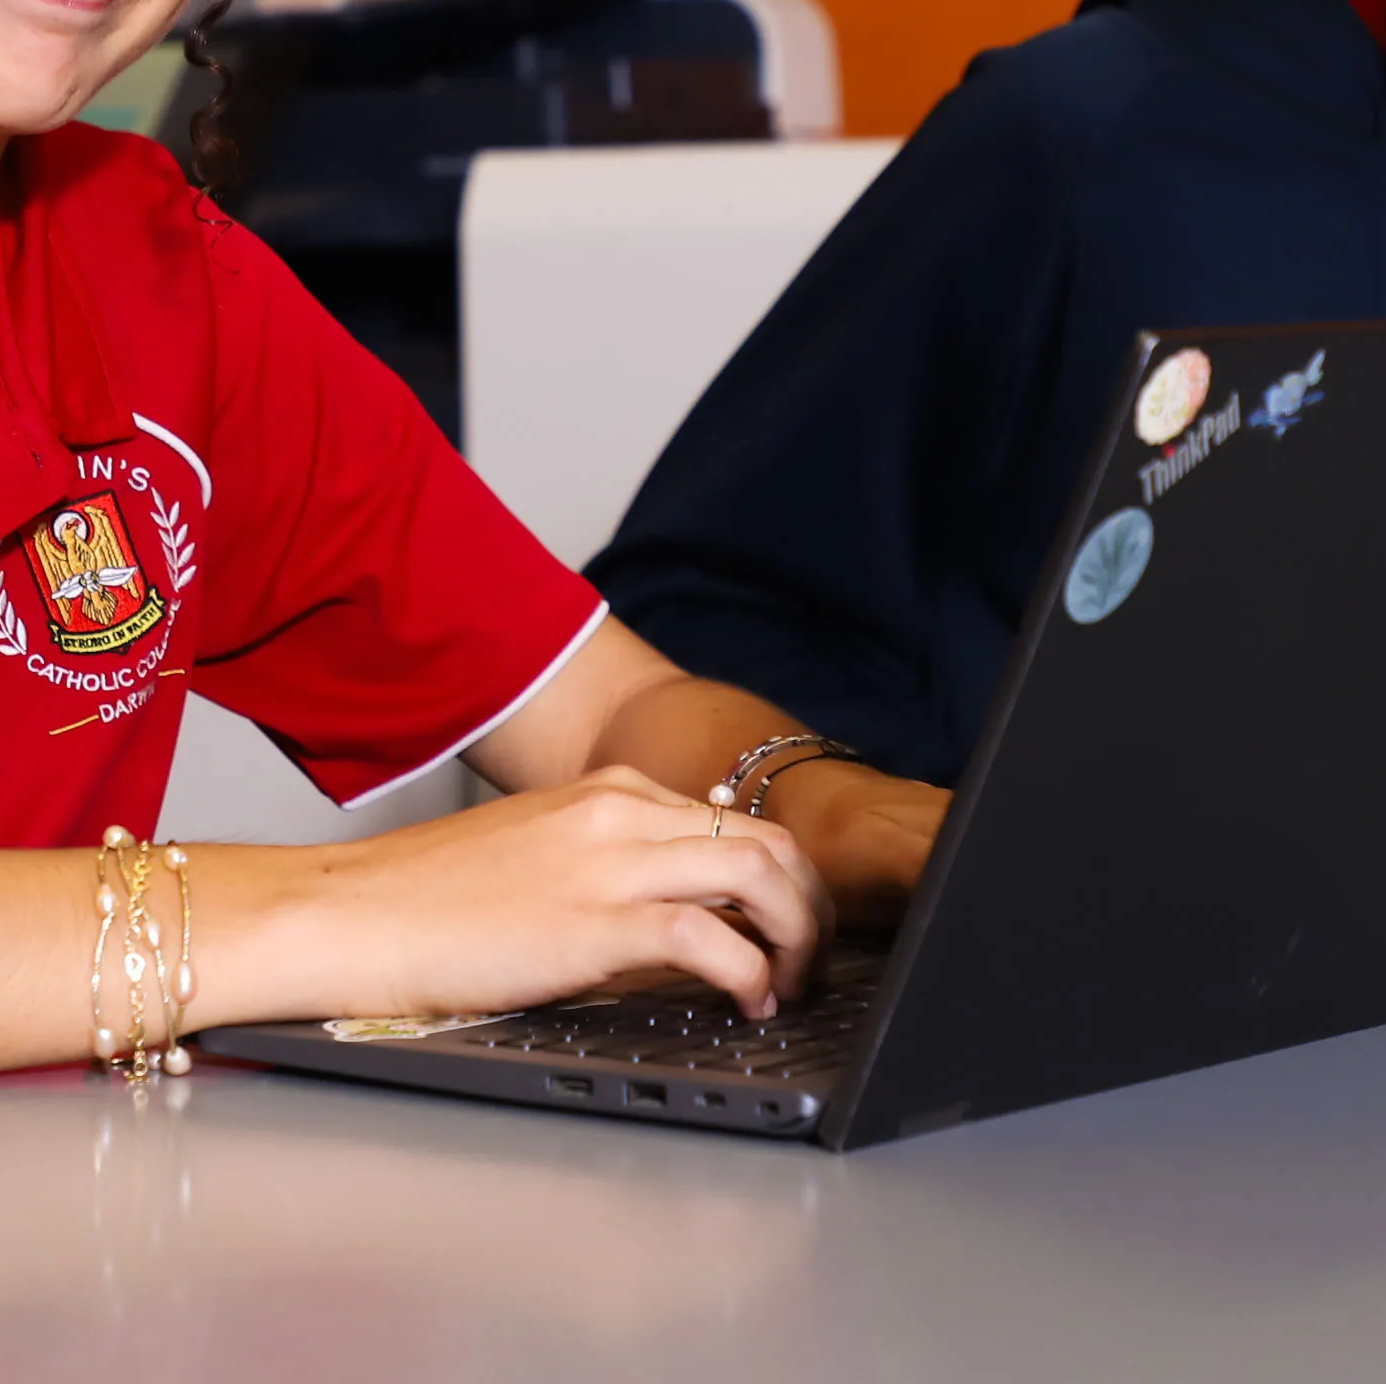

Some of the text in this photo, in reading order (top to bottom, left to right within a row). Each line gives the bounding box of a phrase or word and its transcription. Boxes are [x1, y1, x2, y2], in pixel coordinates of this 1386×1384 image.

[1138, 389, 1241, 505] ThinkPad
[112, 628, 127, 642] IN
[125, 606, 158, 635] FAITH
[26, 653, 135, 692] CATHOLIC
